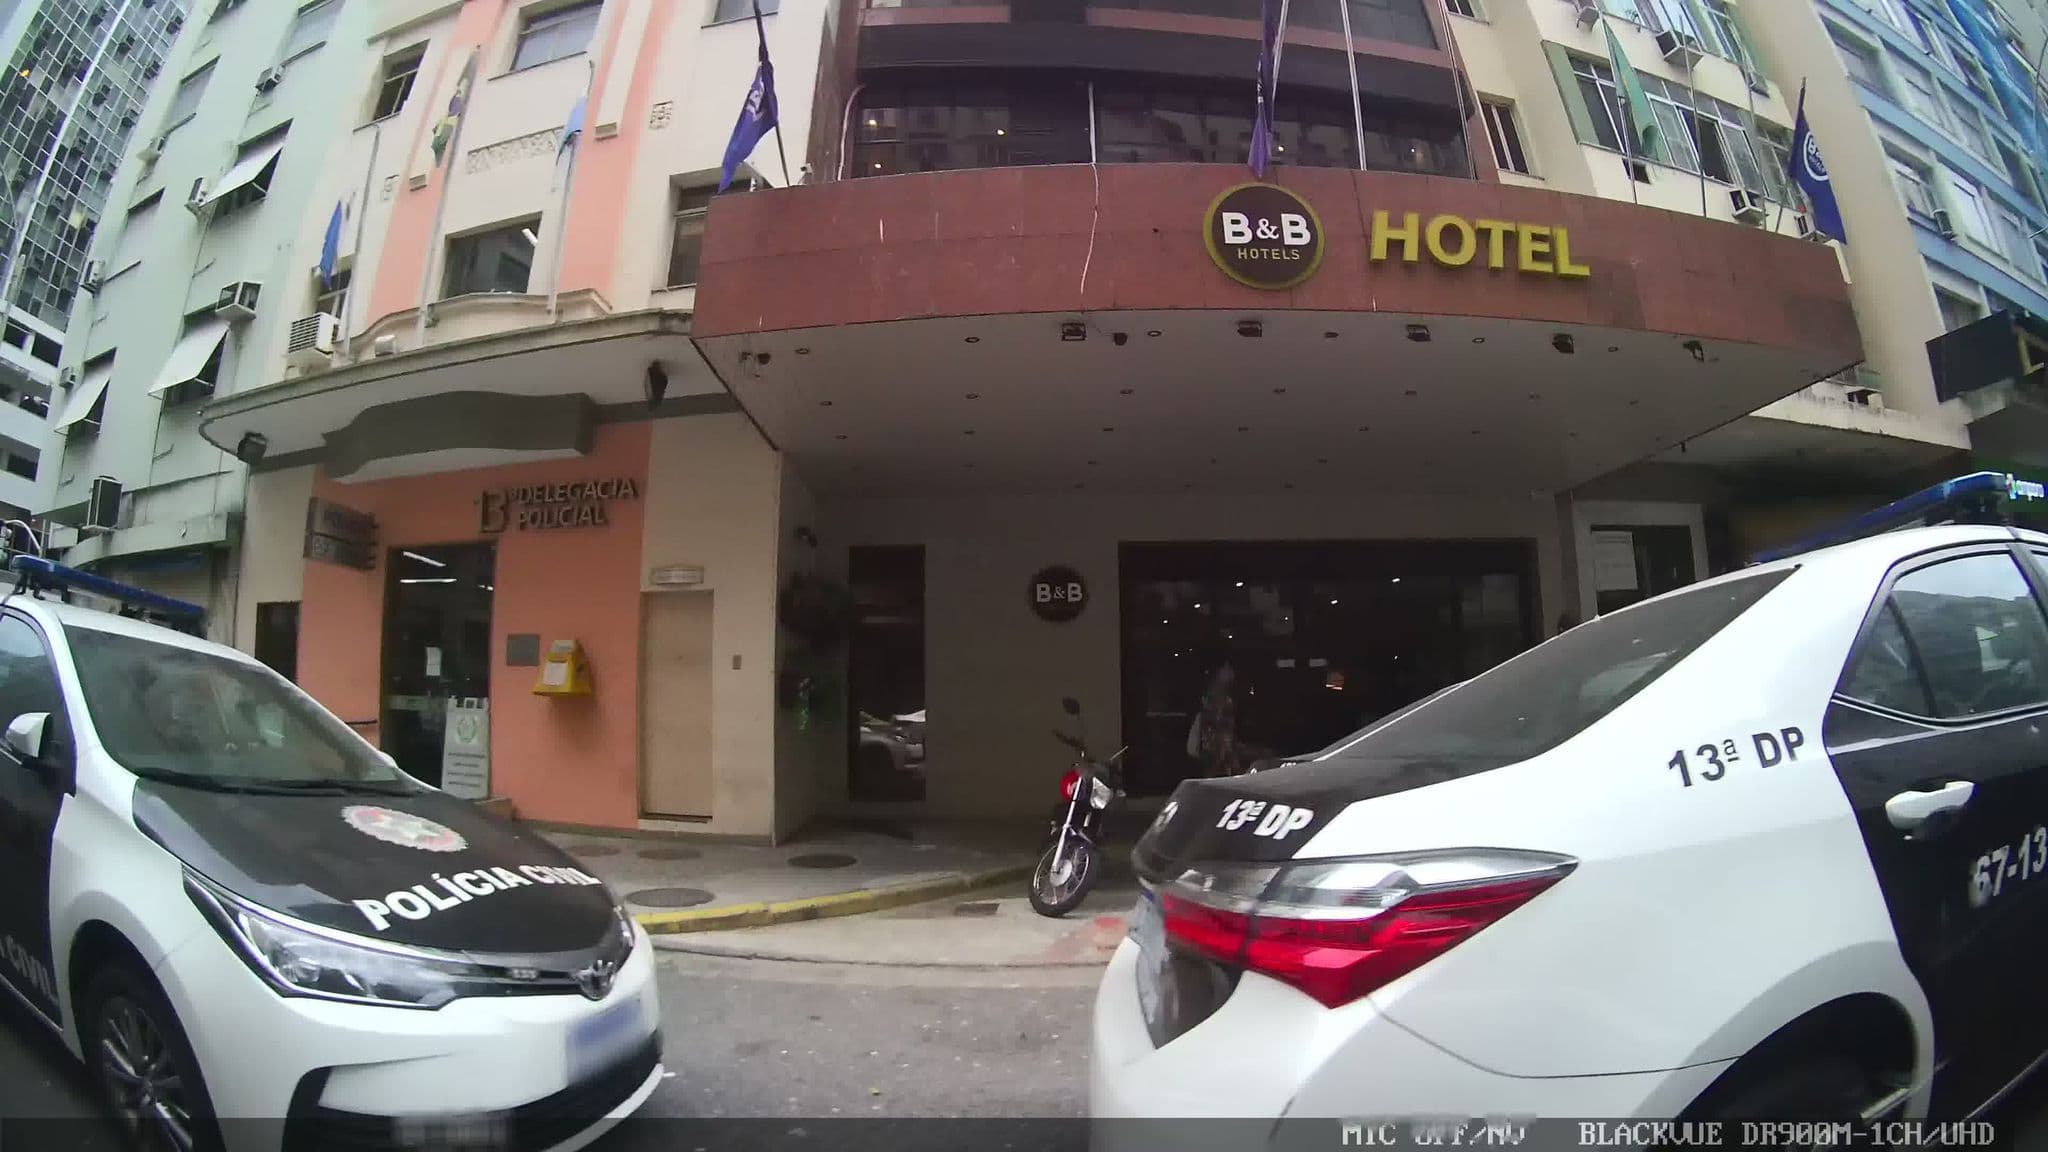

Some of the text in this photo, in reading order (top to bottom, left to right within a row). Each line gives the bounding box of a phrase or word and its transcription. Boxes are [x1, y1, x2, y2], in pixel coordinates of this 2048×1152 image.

[1222, 212, 1311, 245] B&B
[1370, 210, 1591, 277] HOTEL
[1238, 248, 1301, 260] HOTELS
[519, 477, 637, 504] DELEGACIA
[519, 503, 607, 531] POLICIAL
[1036, 582, 1083, 603] B&B
[1668, 726, 1804, 787] 13ª DP
[1253, 804, 1314, 840] DP
[352, 865, 602, 931] POLÍCIA CIVIL
